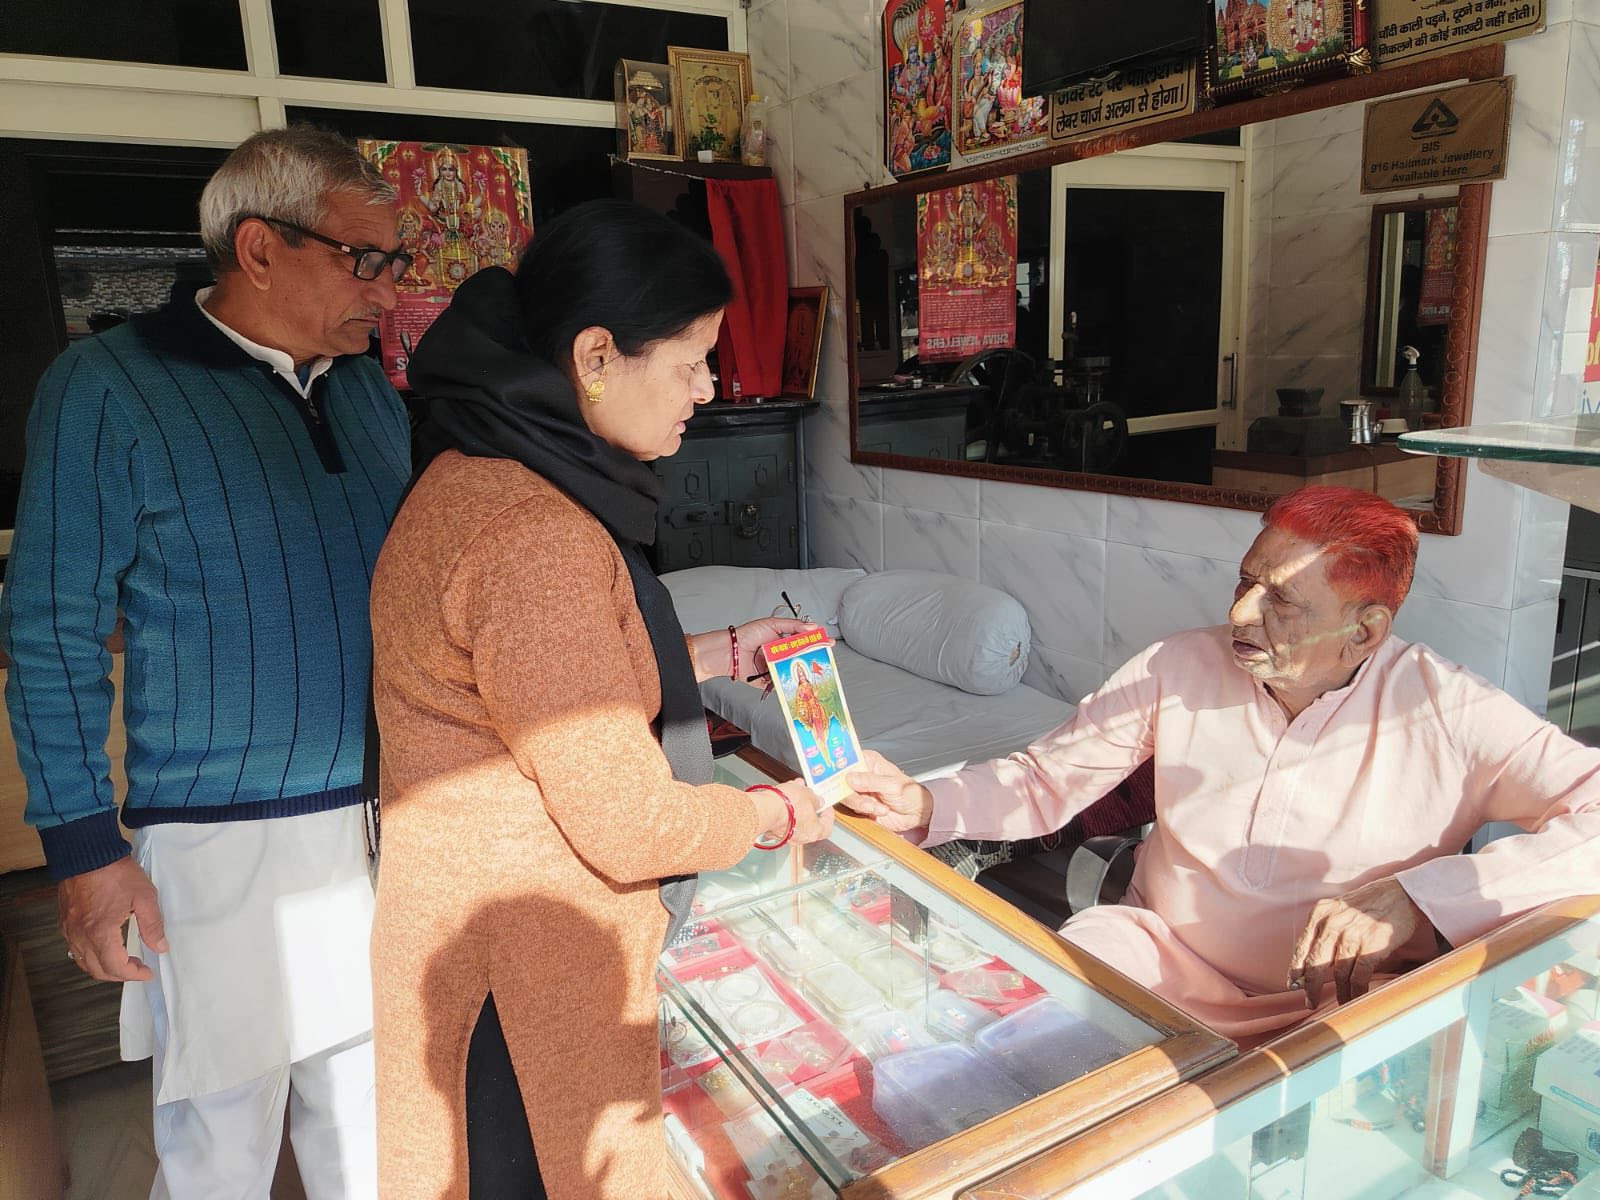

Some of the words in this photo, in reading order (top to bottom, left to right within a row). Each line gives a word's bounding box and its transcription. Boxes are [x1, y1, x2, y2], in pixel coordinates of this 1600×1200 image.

[1399, 16, 1423, 33] काली
[1414, 34, 1428, 47] की
[1429, 26, 1450, 43] कोई
[1485, 10, 1506, 28] नहीं
[1055, 110, 1080, 133] लेबर
[1080, 98, 1103, 125] चार्ज
[1104, 97, 1135, 121] अलग
[1138, 88, 1149, 112] से
[1421, 140, 1441, 153] BIS
[1370, 162, 1391, 174] 916
[1391, 168, 1440, 183] Available
[1442, 165, 1469, 177] Here
